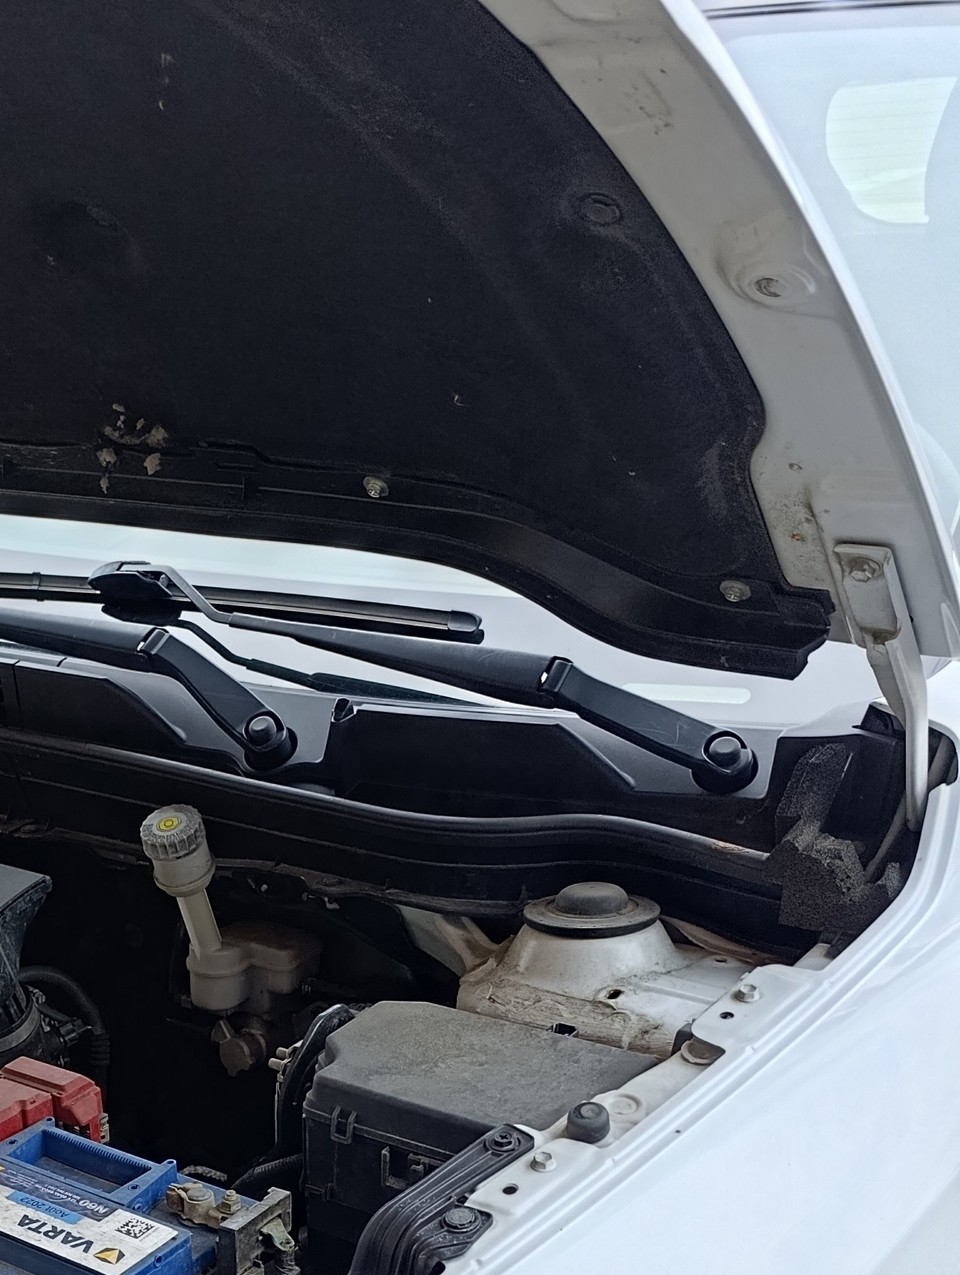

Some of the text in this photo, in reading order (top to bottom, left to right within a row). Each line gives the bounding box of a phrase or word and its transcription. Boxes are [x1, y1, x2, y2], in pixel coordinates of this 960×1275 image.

[20, 1197, 46, 1209] 2022
[79, 1199, 110, 1214] N60
[17, 1214, 94, 1254] VARTA
